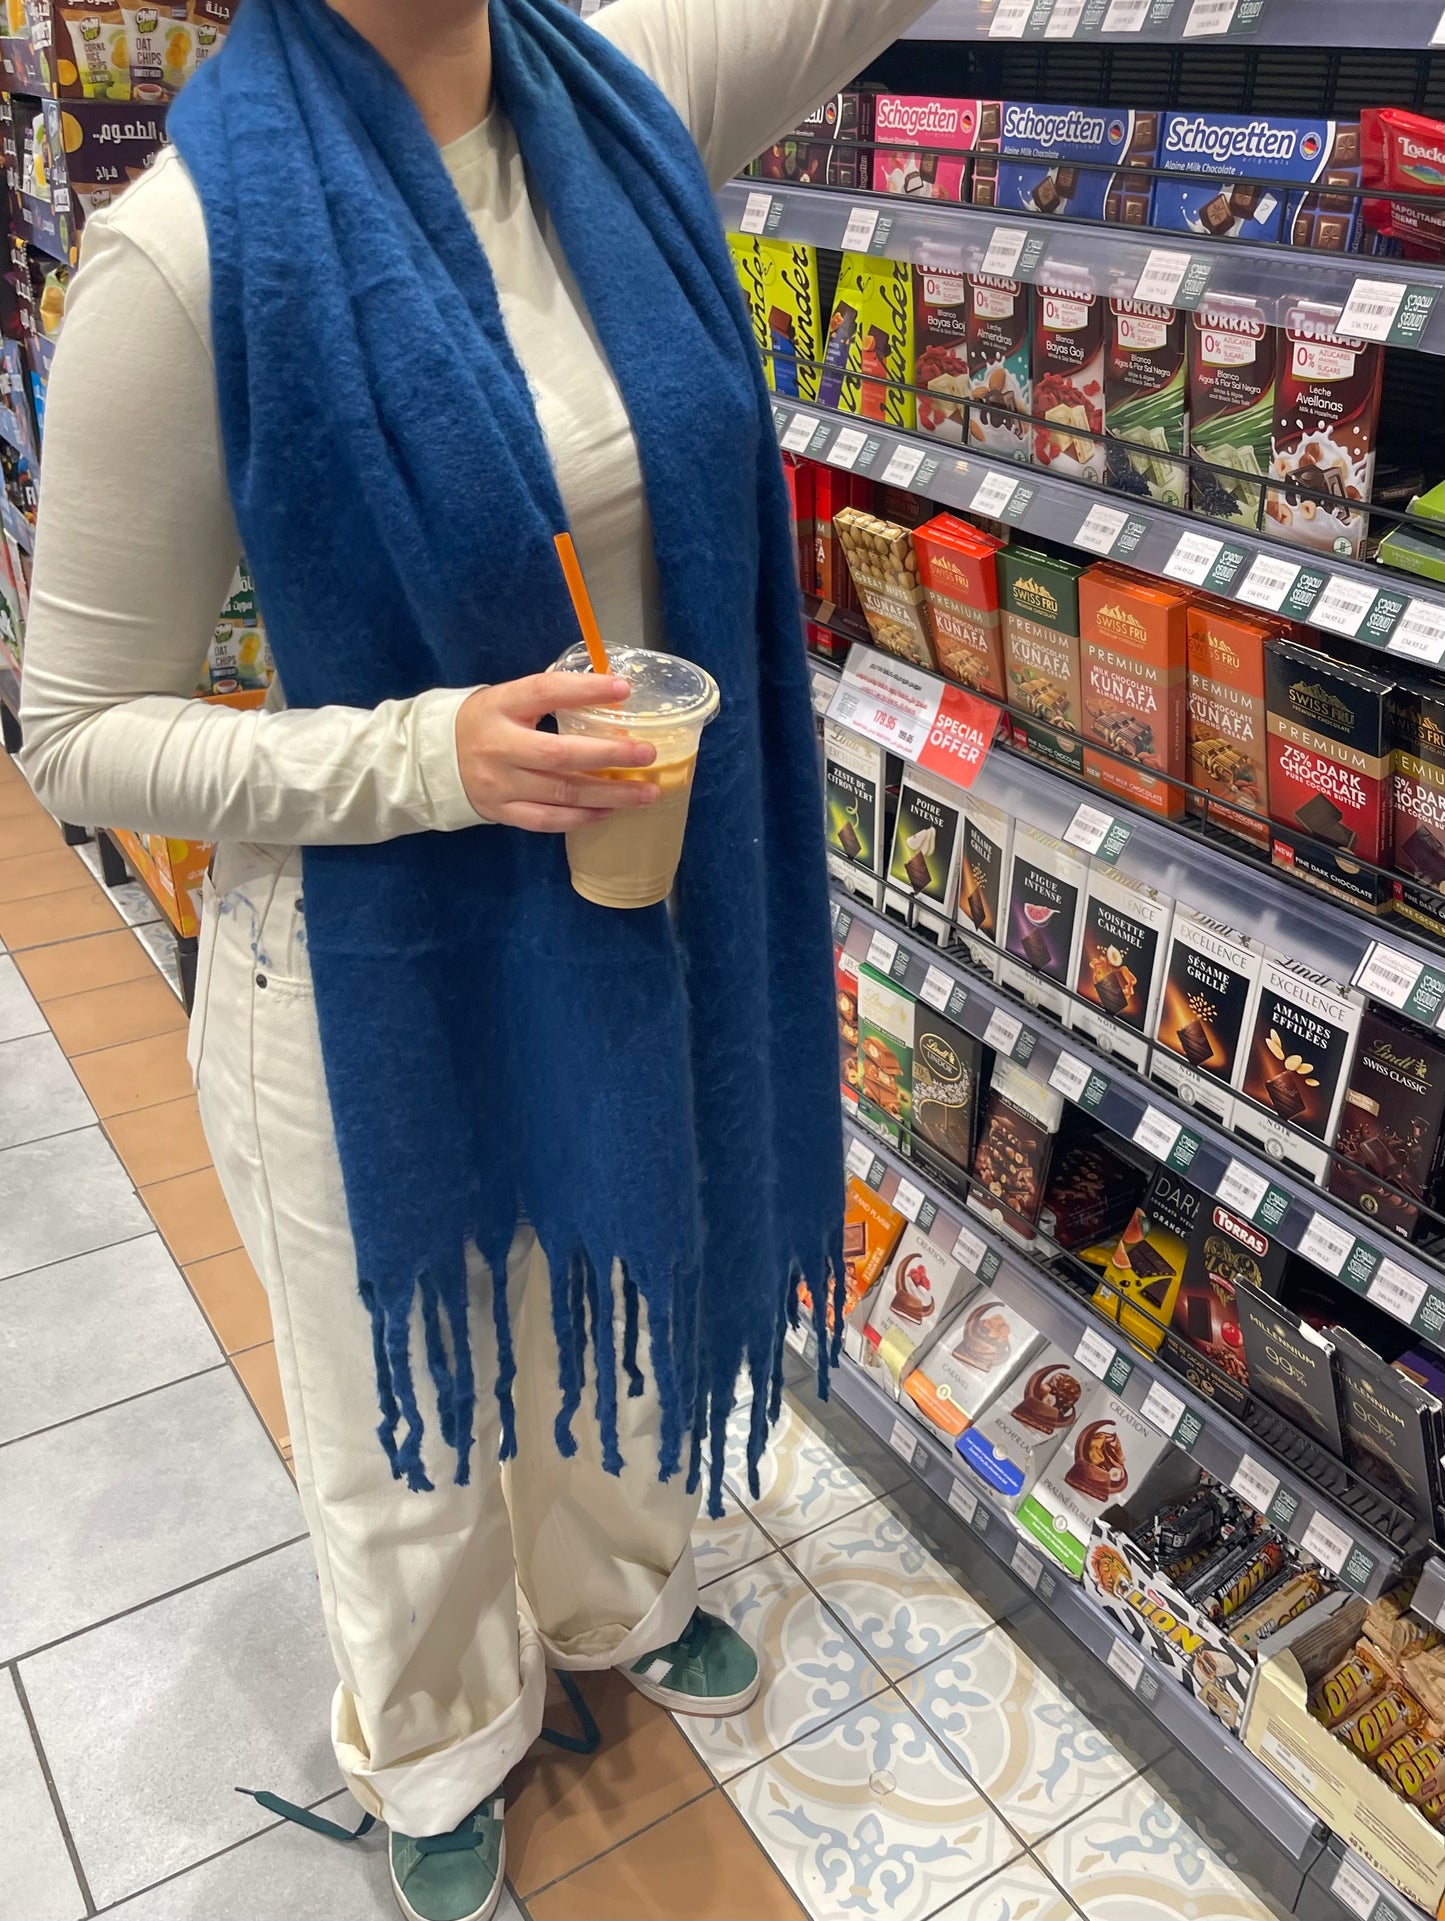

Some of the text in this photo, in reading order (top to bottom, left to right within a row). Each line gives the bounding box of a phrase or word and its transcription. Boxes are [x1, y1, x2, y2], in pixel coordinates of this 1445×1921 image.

[136, 38, 151, 51] OAT
[137, 52, 162, 66] CHIPS
[195, 47, 209, 59] OAT
[878, 100, 960, 135] Schogetten
[1004, 105, 1105, 148] Schogetten
[1020, 148, 1032, 157] Milk
[1033, 149, 1059, 159] Chocolate
[1165, 116, 1297, 162] Schogetten
[1164, 160, 1236, 175] Alpine Milk Chocolate
[1391, 211, 1418, 228] CREME
[927, 315, 951, 329] Bayas
[937, 309, 957, 320] Blanco
[1200, 311, 1260, 335] TORRAS
[977, 328, 1013, 346] Almendras
[1046, 340, 1085, 359] Bayas Goji
[1055, 334, 1075, 345] Blanco
[1130, 353, 1152, 366] Blanco
[1296, 346, 1315, 369] 0%
[1317, 364, 1341, 376] SUGARS
[1216, 369, 1240, 382] Blanco
[1220, 379, 1231, 388] Flor
[1296, 392, 1344, 413] Avellanas
[1309, 385, 1332, 397] Leche
[854, 572, 884, 590] GREAT
[885, 585, 909, 601] NUTS
[955, 575, 969, 588] FRU
[865, 593, 911, 622] KUNAFA
[929, 592, 984, 623] PREMIUM
[1012, 586, 1058, 612] SWISS FRU
[935, 614, 989, 650] KUNAFA
[1008, 615, 1070, 649] PREMIUM
[1096, 613, 1148, 642] SWISS FRU
[214, 646, 228, 656] OAT
[215, 655, 237, 667] CHIPS
[1010, 633, 1070, 662] BLOND CHOCOLATE
[1011, 640, 1071, 677] KUNAFA
[1221, 652, 1240, 669] FRU
[1088, 644, 1157, 681] PREMIUM
[1089, 671, 1157, 712] KUNAFA
[1093, 664, 1153, 695] MILK CHOCOLATE
[1190, 672, 1254, 710] REMIUM
[1096, 687, 1150, 715] ALMOND CREAM
[1209, 700, 1253, 725] CHOCOLATE
[1288, 688, 1355, 726] SWISS FRU
[872, 709, 898, 731] 179.95
[936, 713, 985, 747] SPECIAL
[1187, 698, 1254, 740] KUNAFA
[1191, 714, 1248, 743] ALMOND CREAM
[929, 729, 981, 765] OFFER
[1278, 721, 1367, 769] PREMIUM
[833, 767, 867, 791] ZESTE DE
[1086, 765, 1101, 779] NEW
[1279, 756, 1367, 806] CHOCOLATE
[1282, 744, 1362, 790] 75% DARK
[827, 772, 874, 803] CITRON VERT
[1128, 782, 1163, 802] CHOCOLATE
[1285, 769, 1361, 810] PURE COCOA BUTTER
[909, 804, 945, 829] INTENSE
[916, 797, 942, 816] POIRE
[1407, 808, 1433, 825] COCOA
[1274, 843, 1293, 858] NEW
[1024, 876, 1063, 905] INTENSE
[1030, 869, 1058, 892] FIGUE
[1295, 856, 1373, 899] FINE DARK CHOCOLATE
[1395, 902, 1439, 931] PURE COCOA
[1418, 900, 1437, 915] DARK
[1096, 917, 1144, 949] CARAMEL
[1097, 907, 1147, 940] NOISETTE
[1180, 922, 1248, 970] EXCELLENCE
[1186, 964, 1228, 995] GRILLÉ
[1187, 952, 1231, 985] SÉSAME
[1274, 952, 1333, 989] Lindt
[1269, 971, 1346, 1022] EXCELLENCE
[1270, 1011, 1329, 1050] EFFILÉES
[1272, 1001, 1332, 1039] AMANDES
[926, 1050, 953, 1075] LINDOR
[1373, 1039, 1417, 1071] Lindt
[1362, 1055, 1428, 1096] SWISS CLASSIC
[1266, 1117, 1292, 1138] NOIR
[850, 1189, 871, 1213] GRAND
[1152, 1211, 1187, 1238] ORANGE
[1217, 1209, 1264, 1253] TORRAS
[1249, 1312, 1316, 1369] MILLENNIUM
[941, 1362, 970, 1392] CARAMEL
[1264, 1345, 1308, 1388] 99%
[995, 1418, 1021, 1446] ROCHER
[1352, 1400, 1397, 1447] 99%
[1222, 1559, 1266, 1617] LION
[1126, 1590, 1206, 1655] LION
